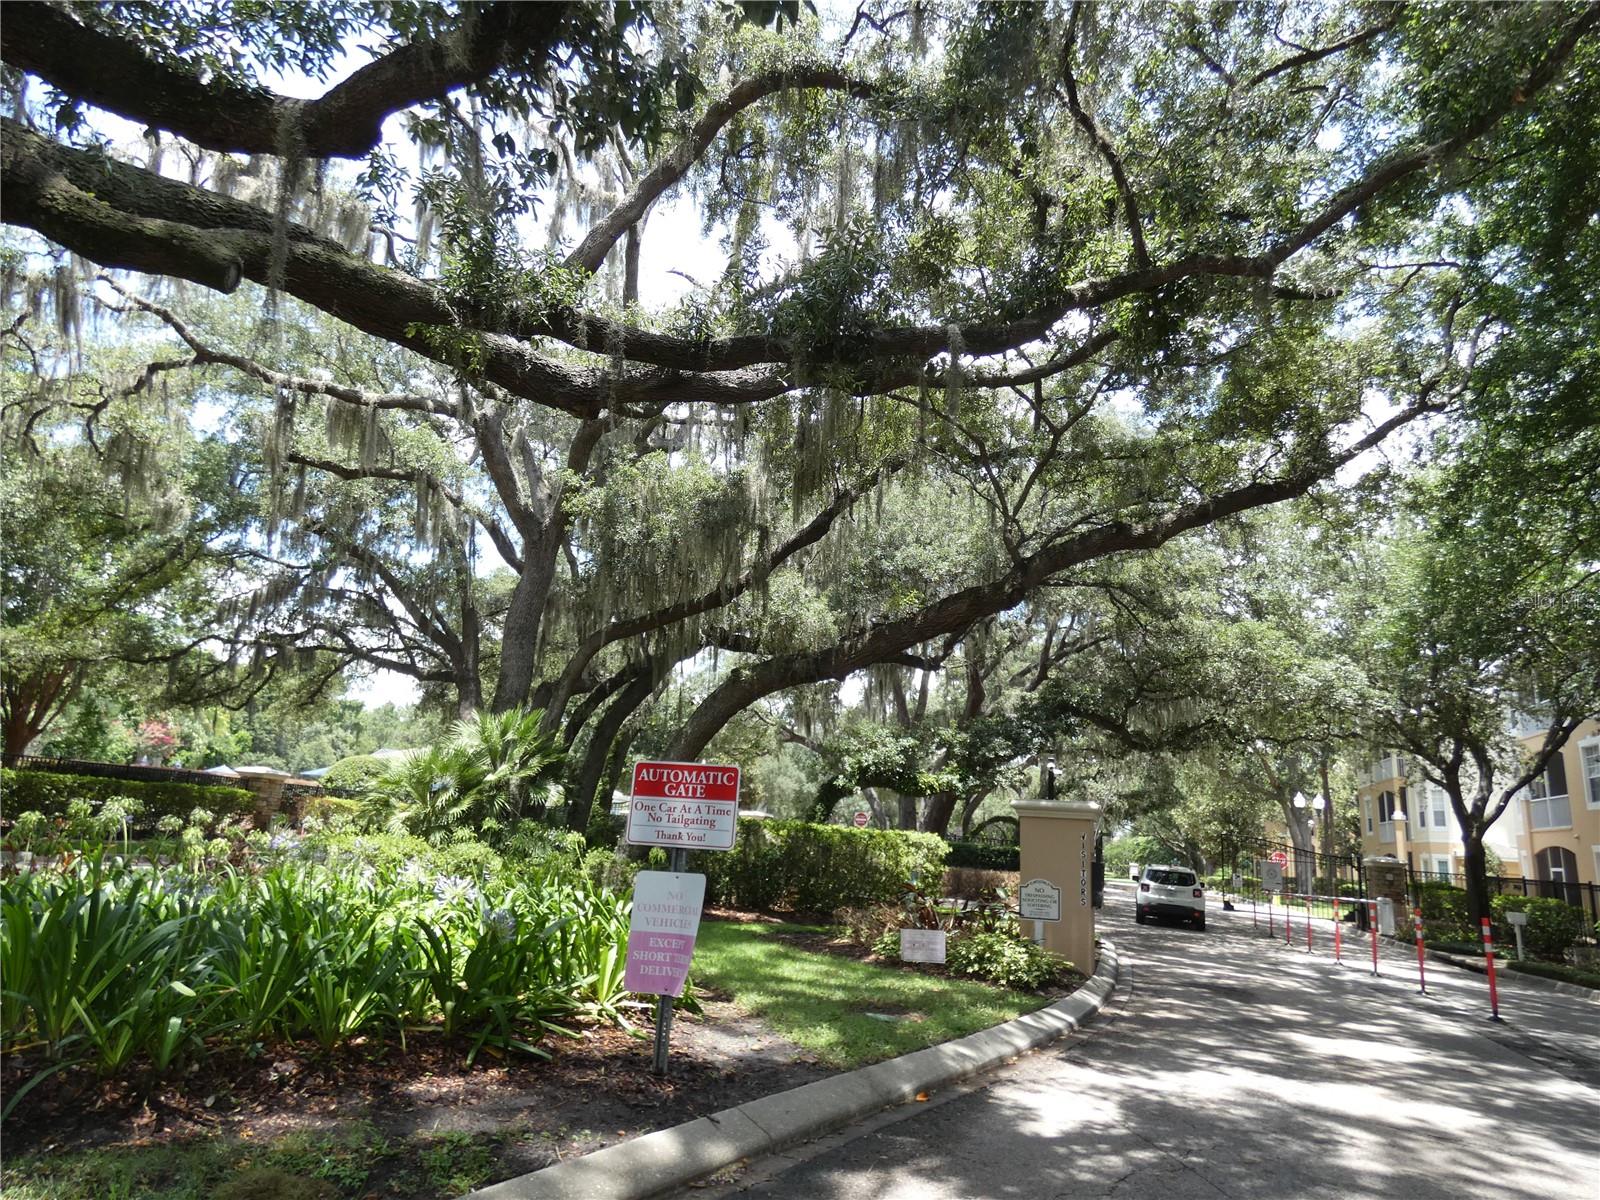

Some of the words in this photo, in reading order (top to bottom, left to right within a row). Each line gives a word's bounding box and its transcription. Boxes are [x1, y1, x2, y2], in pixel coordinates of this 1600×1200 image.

[638, 768, 735, 786] AUTOMATIC
[664, 783, 705, 798] GATE
[634, 801, 656, 812] One
[658, 802, 677, 813] Car
[679, 804, 691, 814] At
[694, 805, 703, 814] A
[705, 805, 731, 816] Time
[647, 812, 662, 823] No
[665, 813, 716, 829] Tailgating
[655, 830, 683, 841] Thank
[686, 832, 706, 842] You!
[633, 951, 672, 962] SHORT
